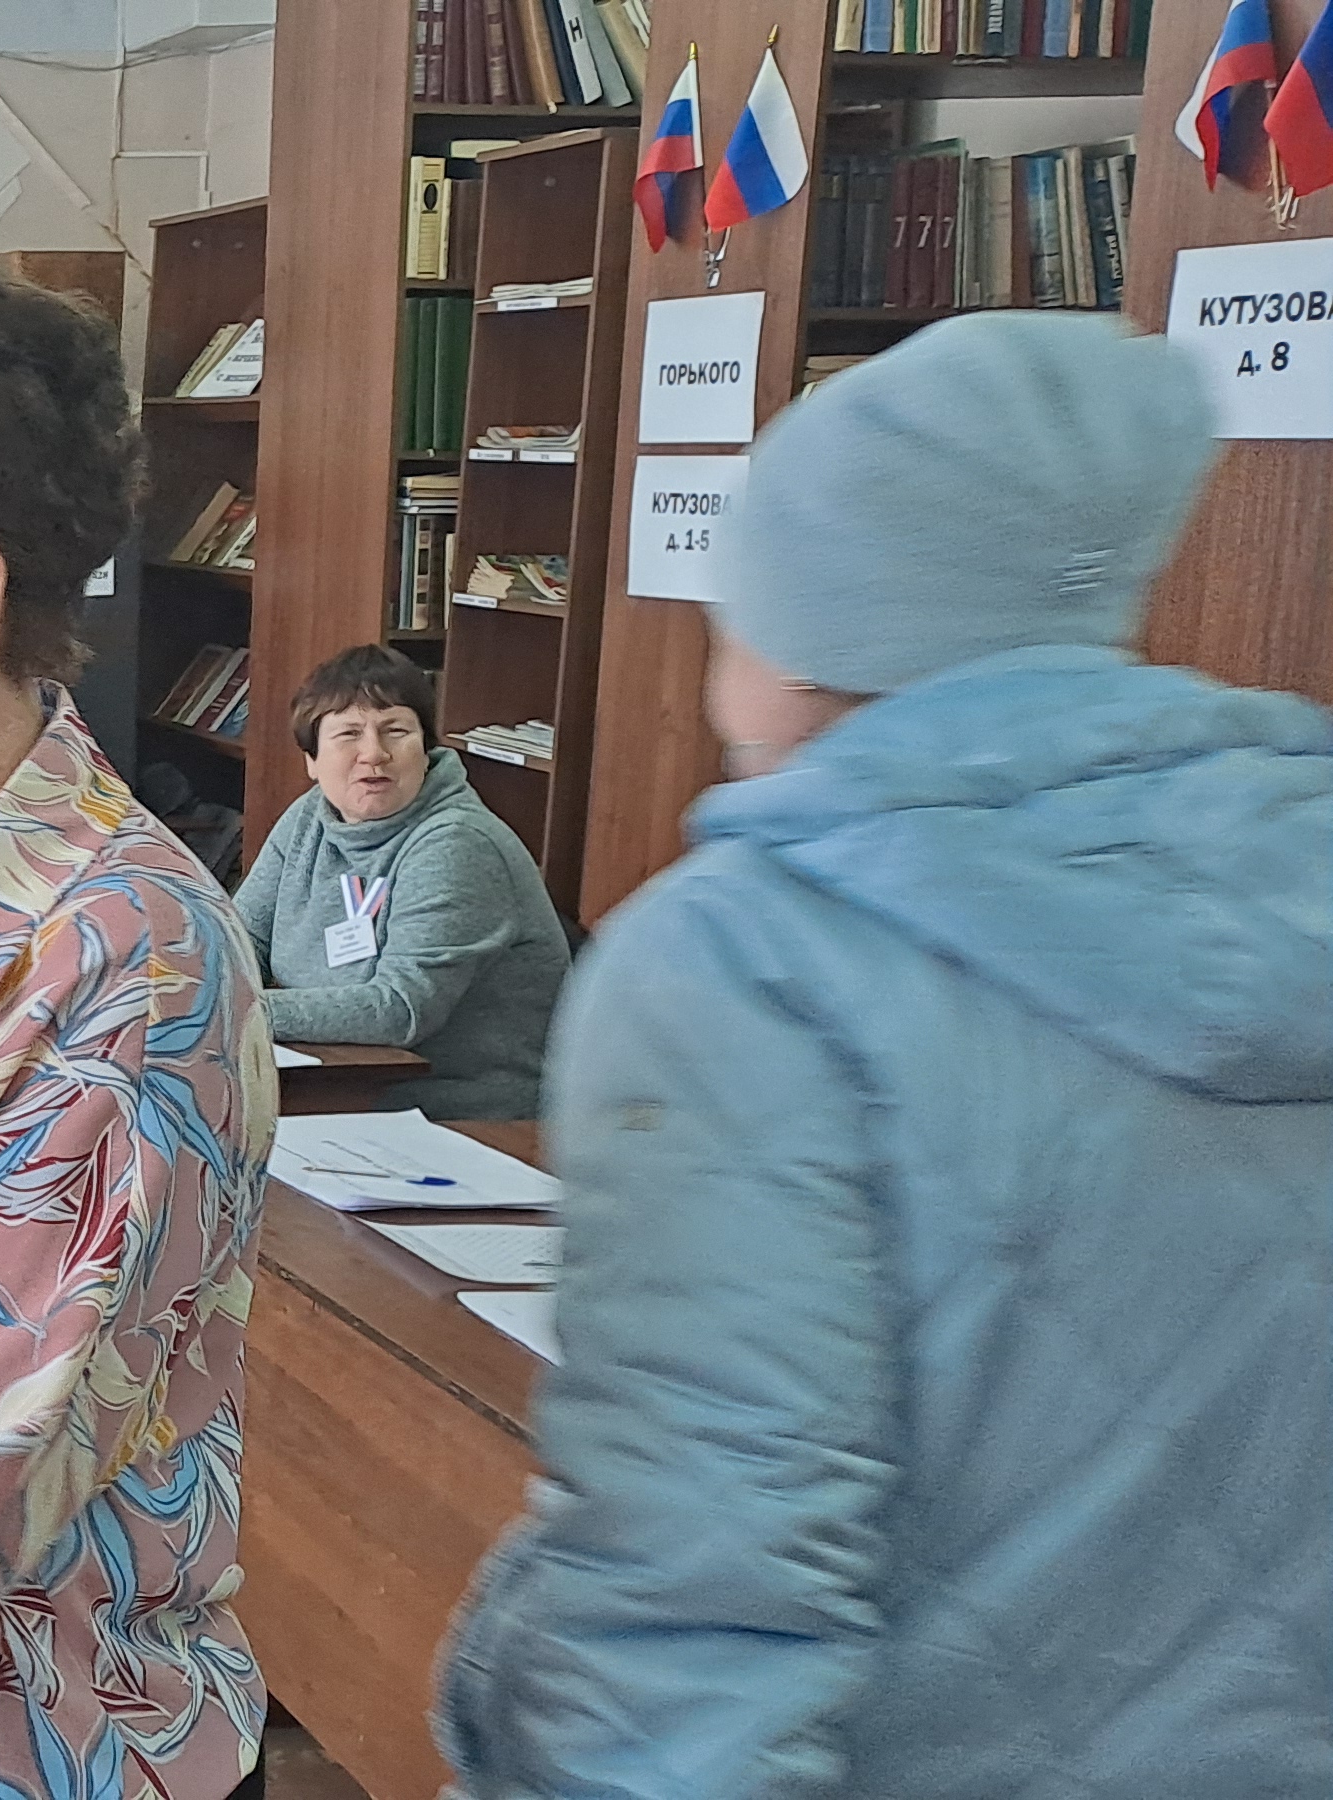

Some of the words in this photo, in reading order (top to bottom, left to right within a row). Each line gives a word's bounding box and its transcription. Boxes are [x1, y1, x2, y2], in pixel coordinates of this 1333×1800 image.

[1199, 290, 1333, 327] КУТУЗОВ
[1271, 341, 1290, 371] 8
[659, 361, 741, 386] ГОРЬКОГО
[685, 529, 710, 551] 1-5
